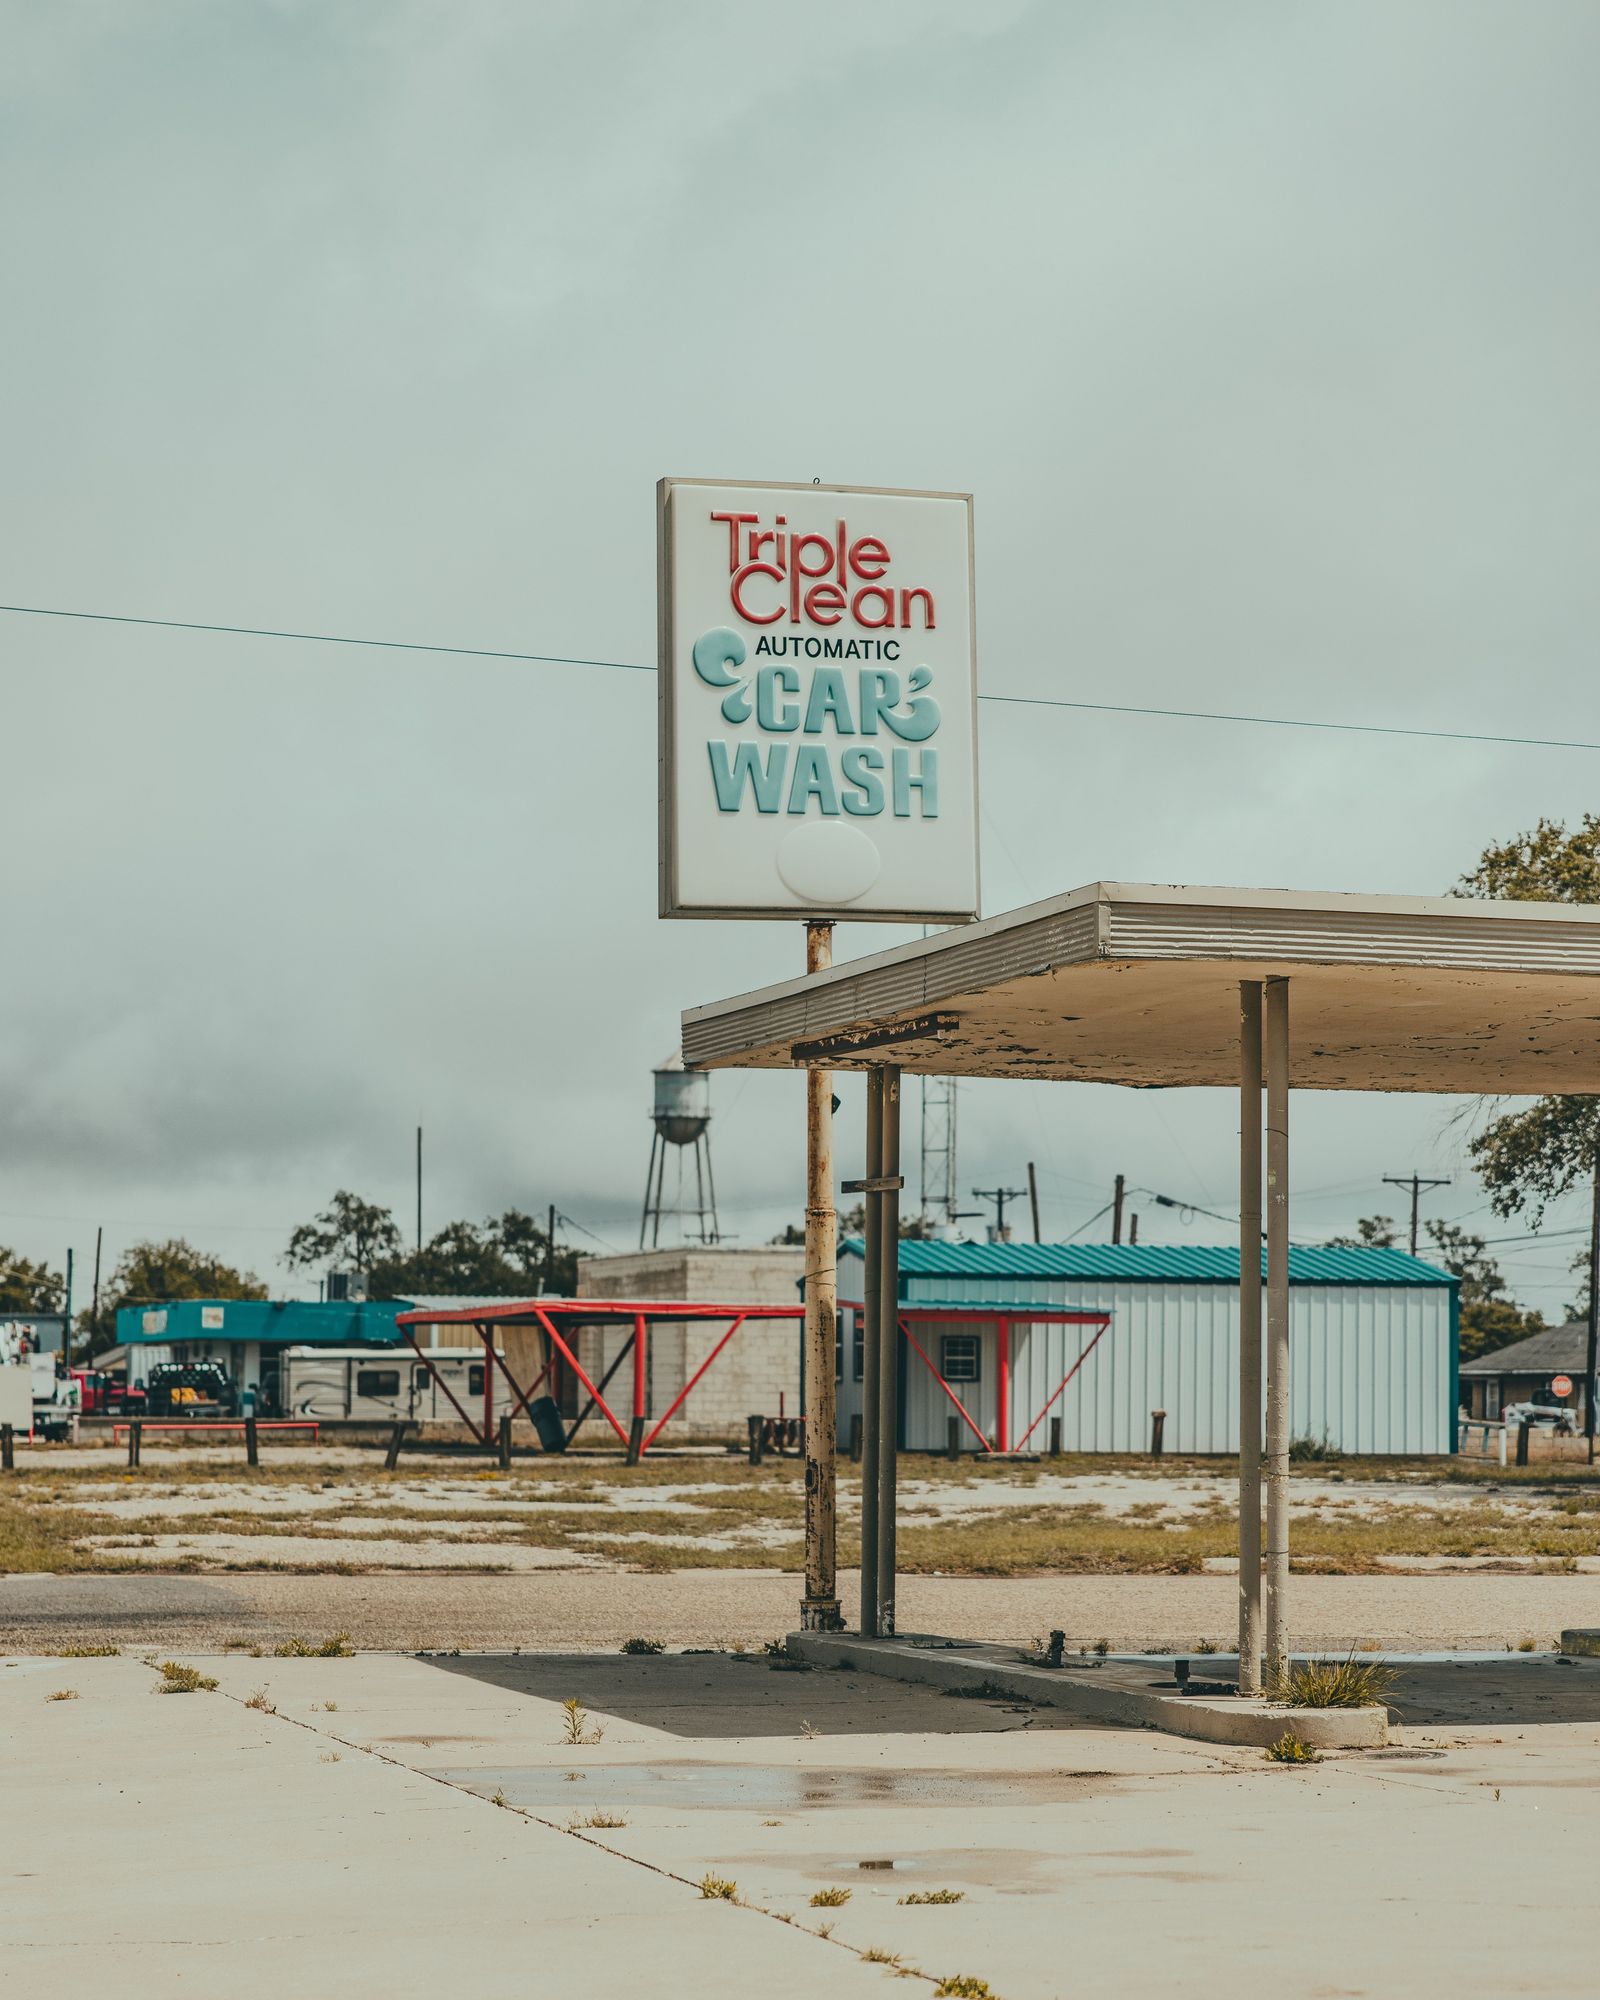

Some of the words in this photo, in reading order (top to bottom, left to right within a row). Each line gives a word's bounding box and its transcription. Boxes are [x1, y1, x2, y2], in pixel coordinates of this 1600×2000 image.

[711, 511, 890, 623] Triple
[731, 562, 936, 629] Clean
[755, 635, 901, 660] AUTOMATIC
[756, 664, 941, 741] CAR
[707, 741, 939, 818] WASH
